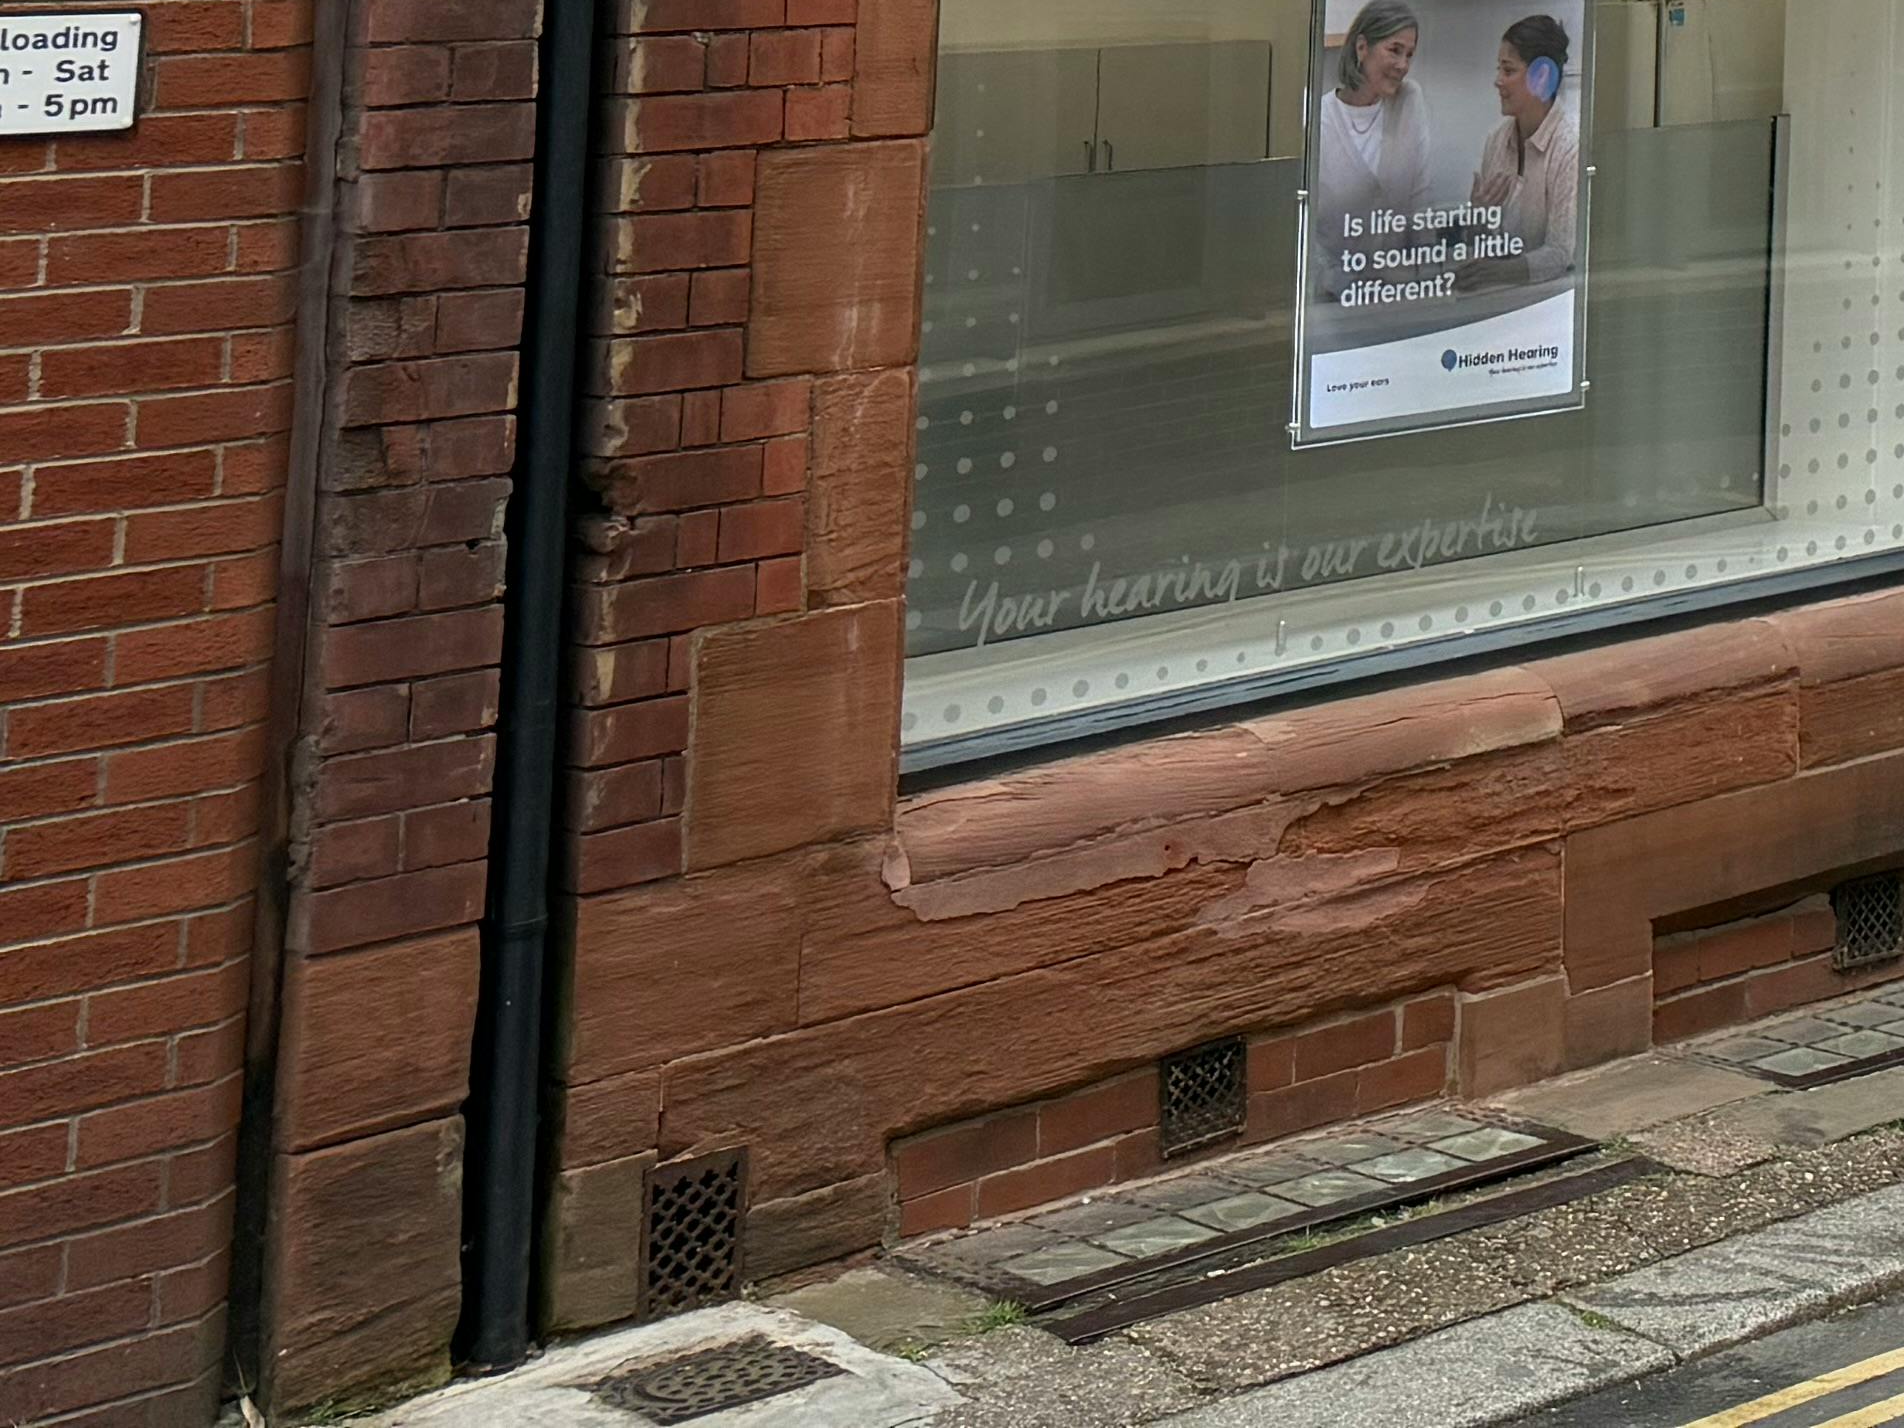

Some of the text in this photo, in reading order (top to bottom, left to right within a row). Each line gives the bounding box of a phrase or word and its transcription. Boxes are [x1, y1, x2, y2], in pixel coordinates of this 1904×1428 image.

[54, 59, 110, 83] Sat
[1343, 201, 1502, 238] Is life starting
[1341, 232, 1525, 272] to sound a little
[1340, 272, 1456, 308] different?
[1458, 351, 1505, 369] Hidden
[1508, 344, 1559, 362] Hearing
[1326, 377, 1390, 393] Love your ears
[958, 491, 1540, 646] Your hearing is our expertise
